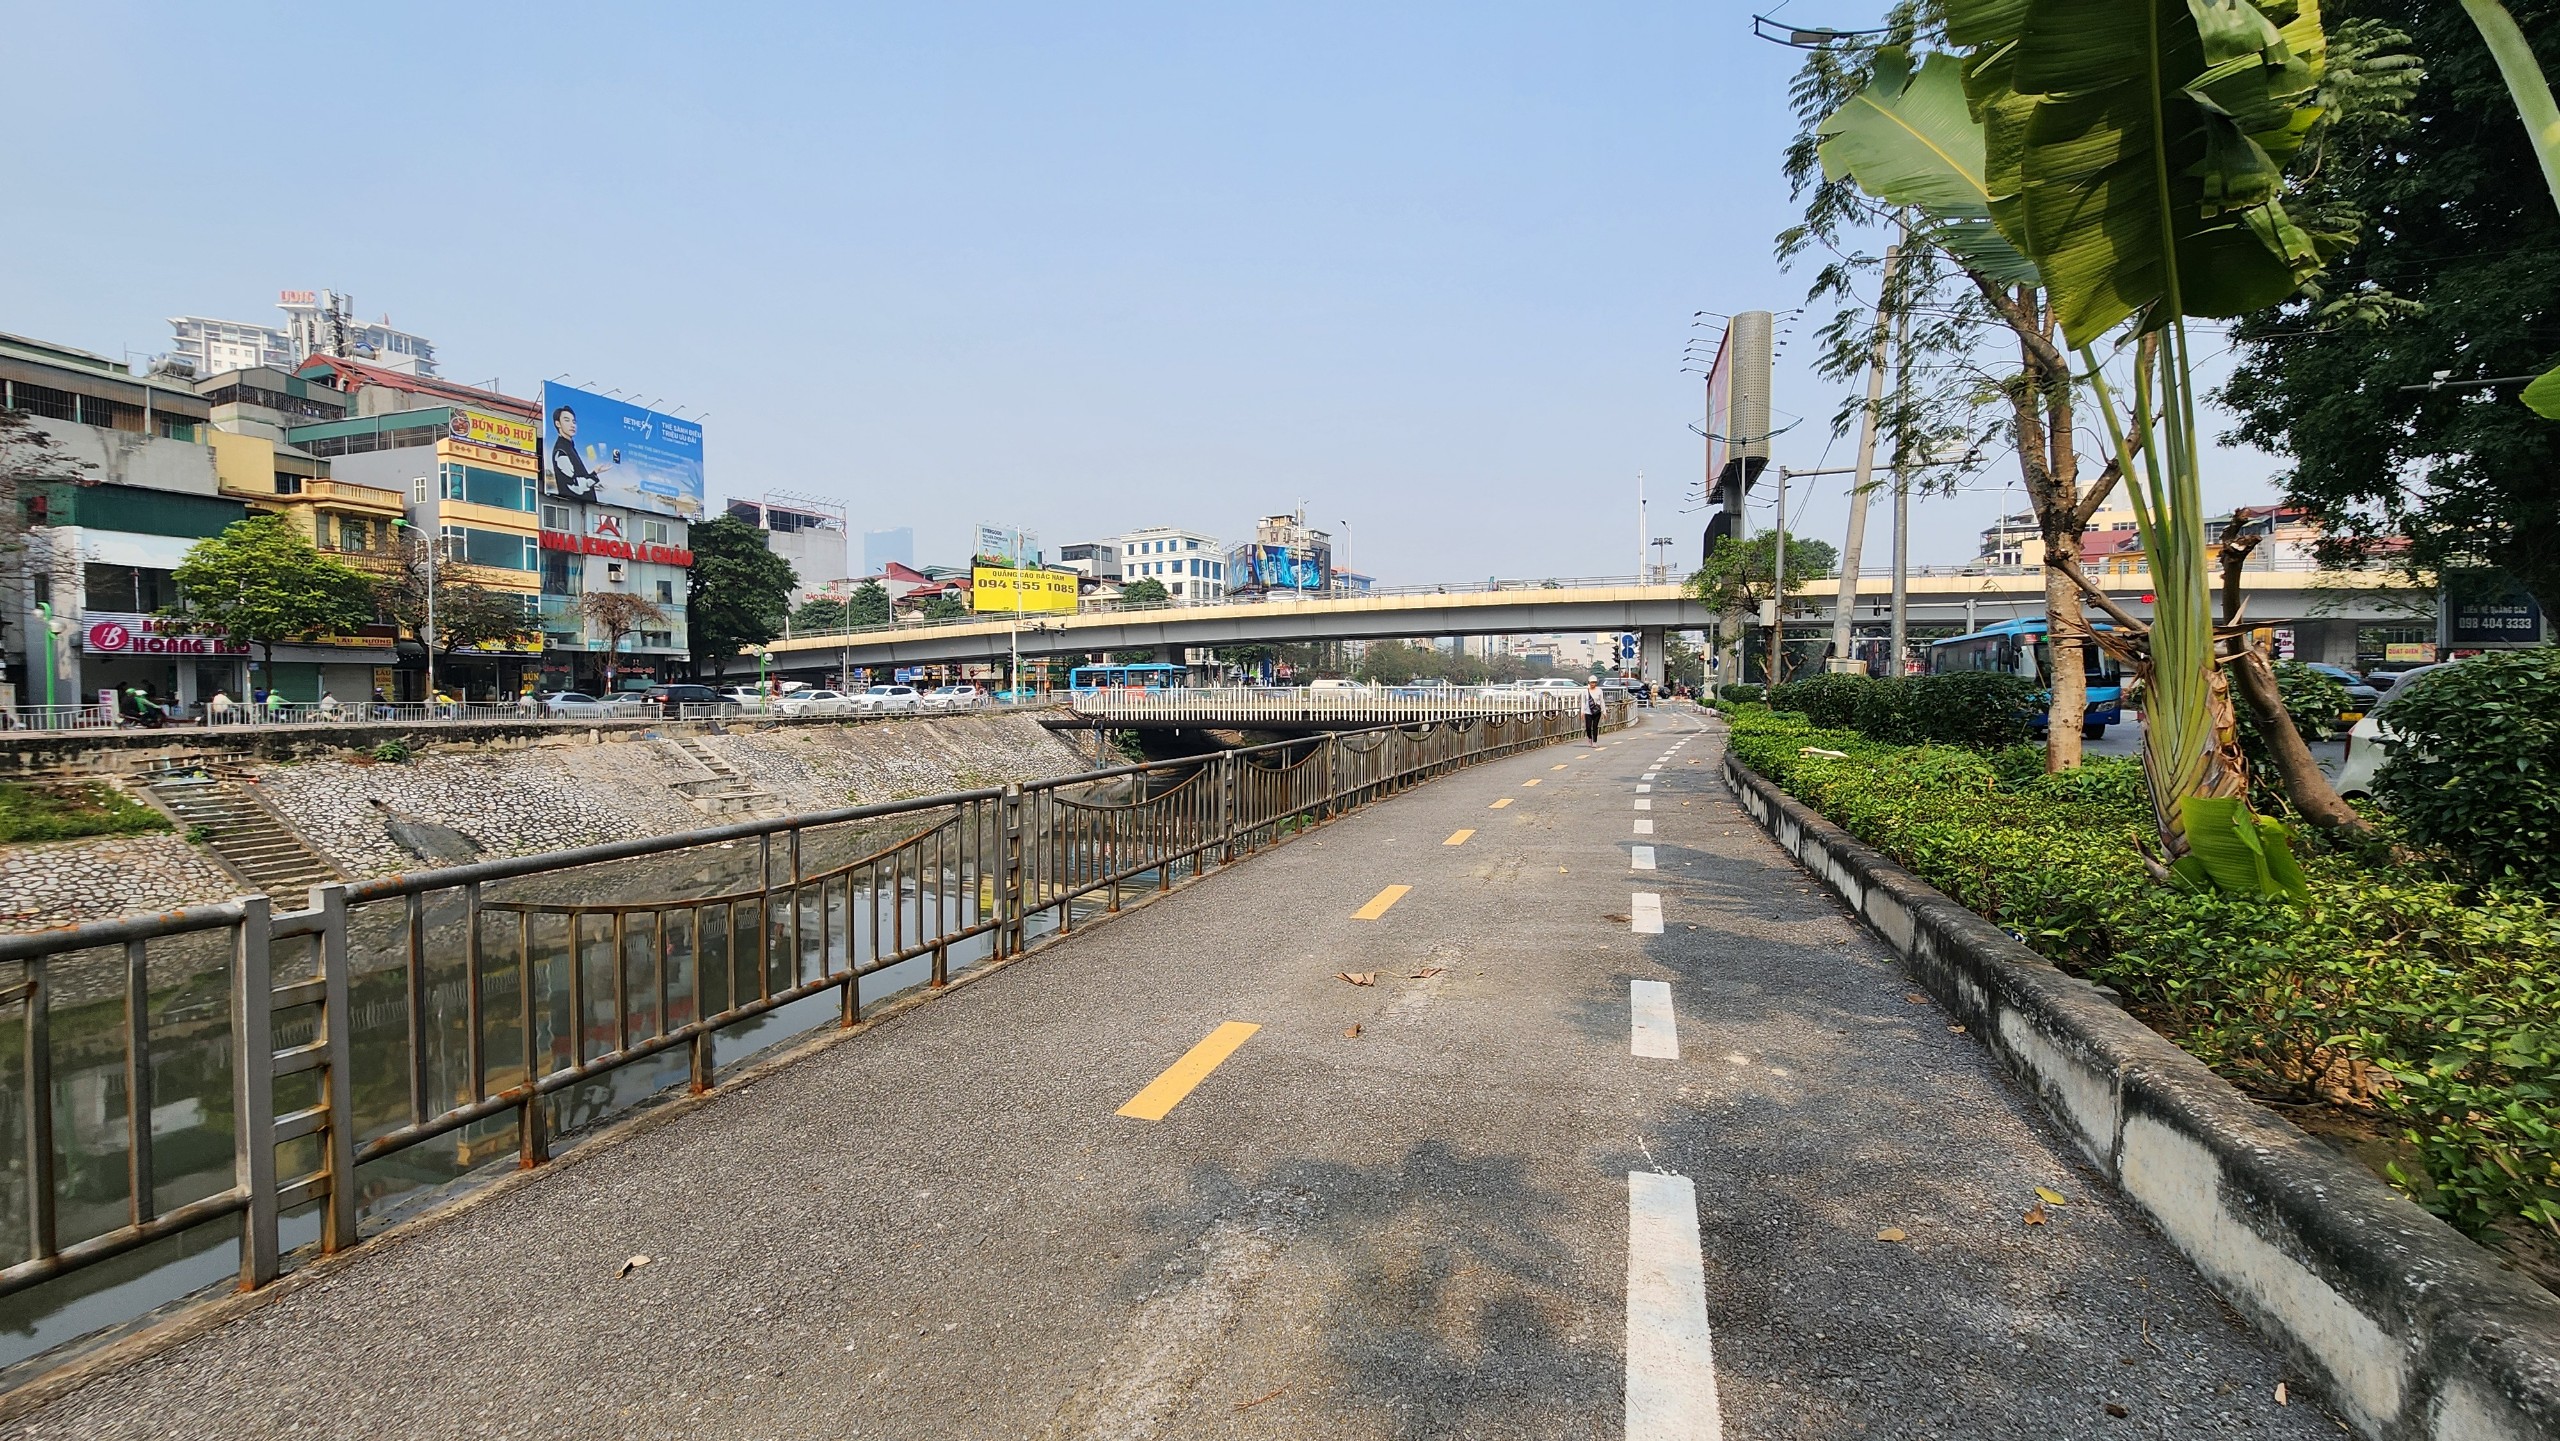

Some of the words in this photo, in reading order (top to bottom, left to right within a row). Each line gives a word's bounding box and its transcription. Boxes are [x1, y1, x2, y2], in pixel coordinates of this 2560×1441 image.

[471, 418, 493, 433] BÚN
[496, 423, 510, 437] BÒ
[513, 428, 534, 442] HUẾ
[539, 530, 579, 552] NHA
[582, 535, 633, 560] KHOA
[635, 540, 649, 561] Á
[651, 544, 694, 566] CHÂU
[992, 570, 1018, 578] QUẢNG
[1036, 571, 1050, 580] BẮC
[1052, 574, 1065, 582] NAM
[978, 579, 1008, 589] 094
[1012, 580, 1040, 591] 555
[1046, 582, 1075, 593] 1085
[2459, 617, 2478, 629] 098
[2481, 617, 2502, 629] 404
[2506, 618, 2531, 629] 3333
